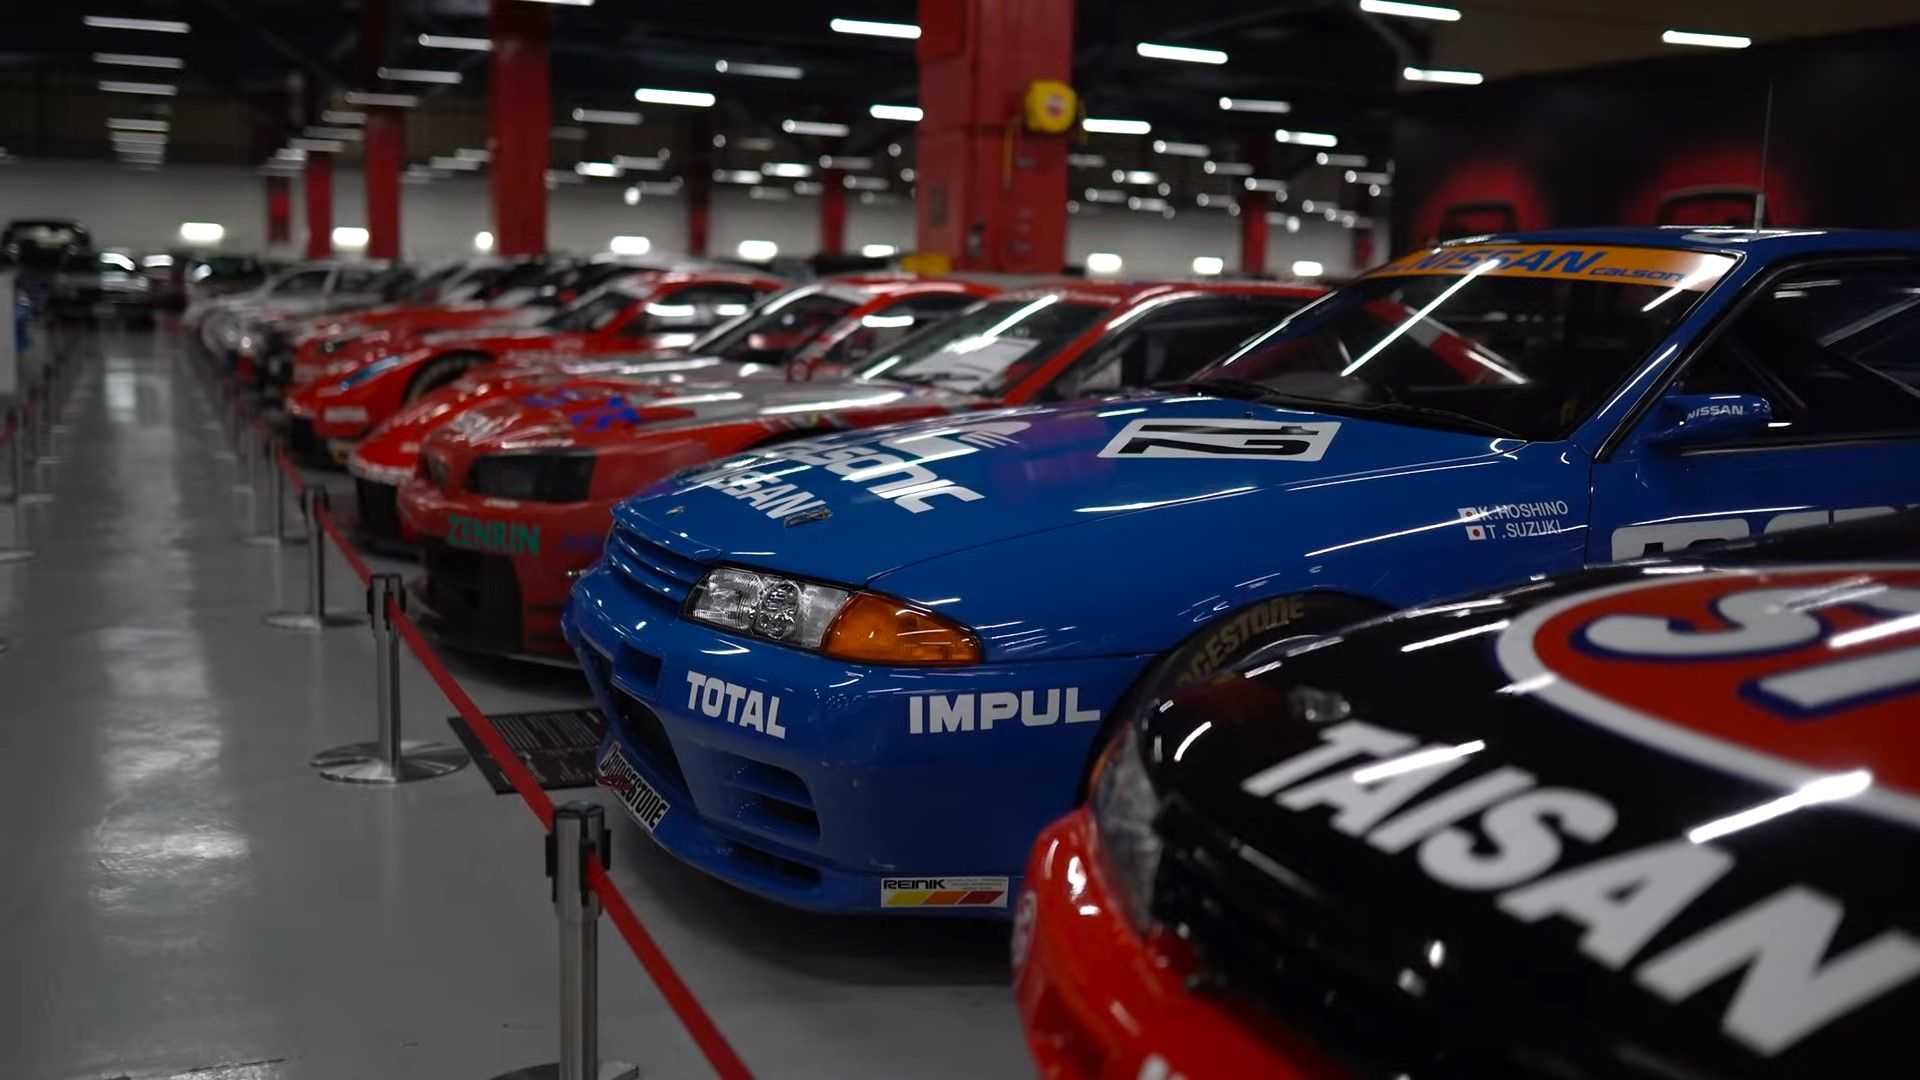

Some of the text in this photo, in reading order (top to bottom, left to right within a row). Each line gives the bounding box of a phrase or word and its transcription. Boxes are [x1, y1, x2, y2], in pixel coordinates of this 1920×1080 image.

[1410, 248, 1605, 274] NISSAN
[1686, 405, 1745, 422] NISSAN
[1478, 500, 1569, 532] K.HOSHINO
[446, 514, 541, 556] ZENRIN
[686, 670, 786, 739] TOTAL
[908, 687, 1101, 735] IMPUL
[883, 879, 945, 890] REINIK
[1242, 719, 1920, 1060] TAISAN
